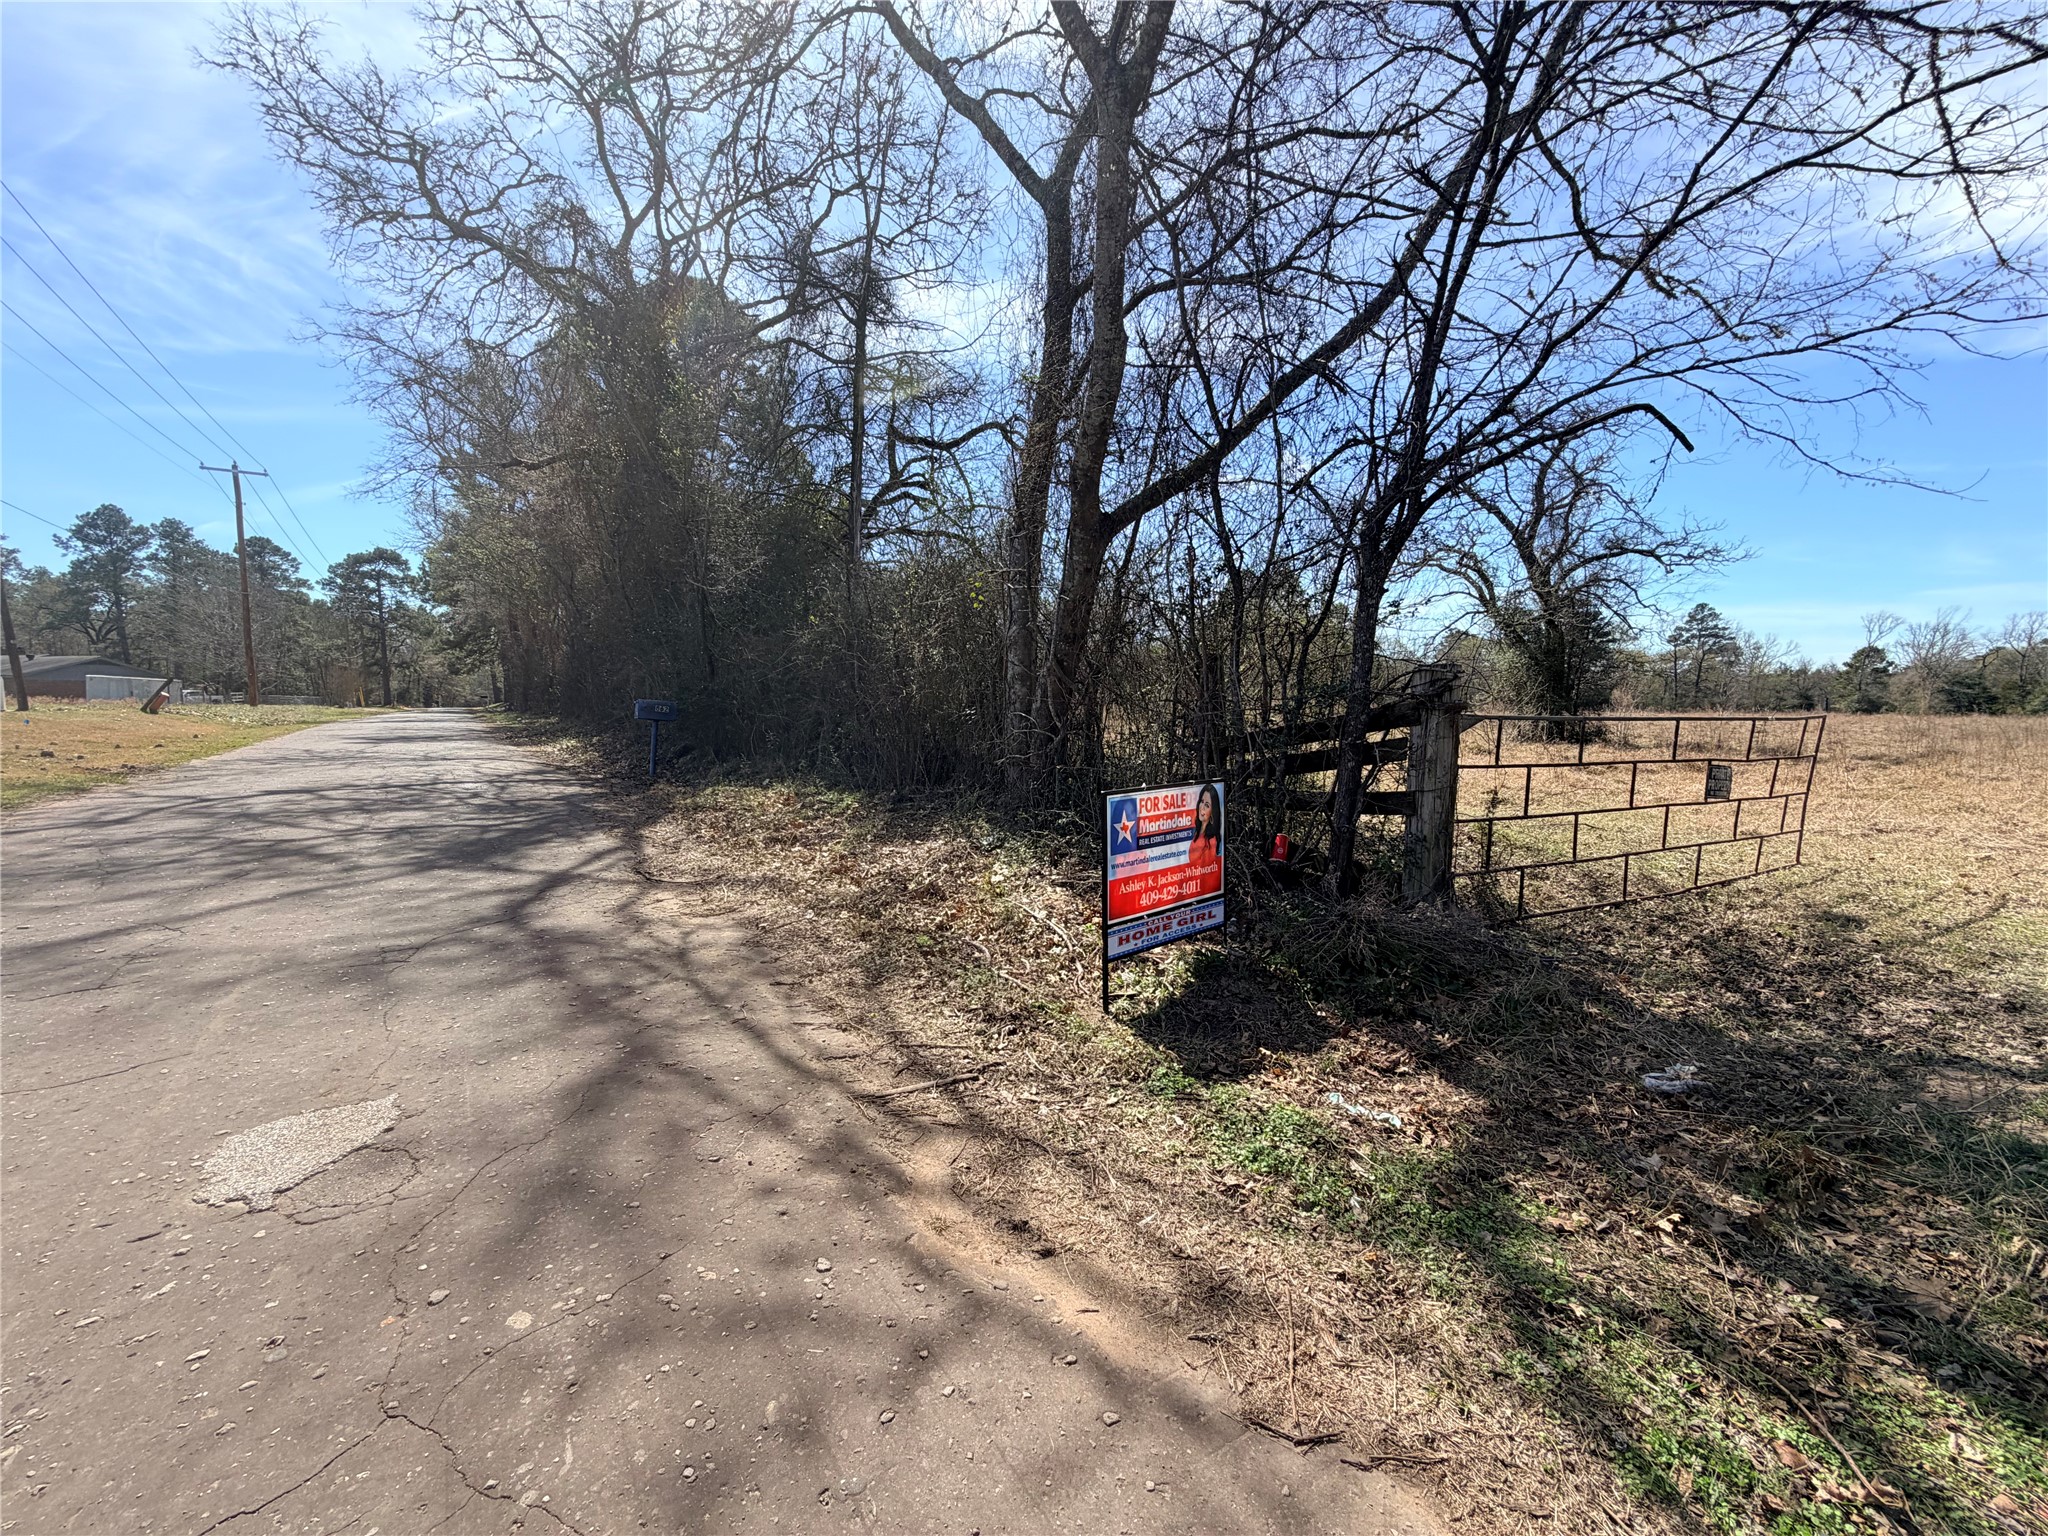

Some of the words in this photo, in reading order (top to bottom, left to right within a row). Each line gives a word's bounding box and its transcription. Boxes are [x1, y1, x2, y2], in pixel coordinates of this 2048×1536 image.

[1138, 796, 1160, 814] FOR
[1162, 793, 1187, 810] SALE
[1139, 814, 1192, 834] Martindale
[1138, 837, 1150, 846] REAL
[1150, 835, 1165, 844] ESTATE
[1165, 830, 1193, 841] INVESTMENTS
[1110, 849, 1187, 870] www.martindalerealestate.com
[1119, 880, 1146, 895] Ashley
[1148, 876, 1157, 888] K.
[1157, 861, 1219, 888] Jackson-Whitworth
[1139, 879, 1201, 907] 409-429-4011
[1117, 921, 1173, 947] HOME
[1177, 910, 1217, 927] GIRL
[1146, 916, 1168, 926] CALL
[1169, 910, 1192, 921] YOUR
[1141, 935, 1160, 945] FOR
[1162, 924, 1197, 938] ACCESS
